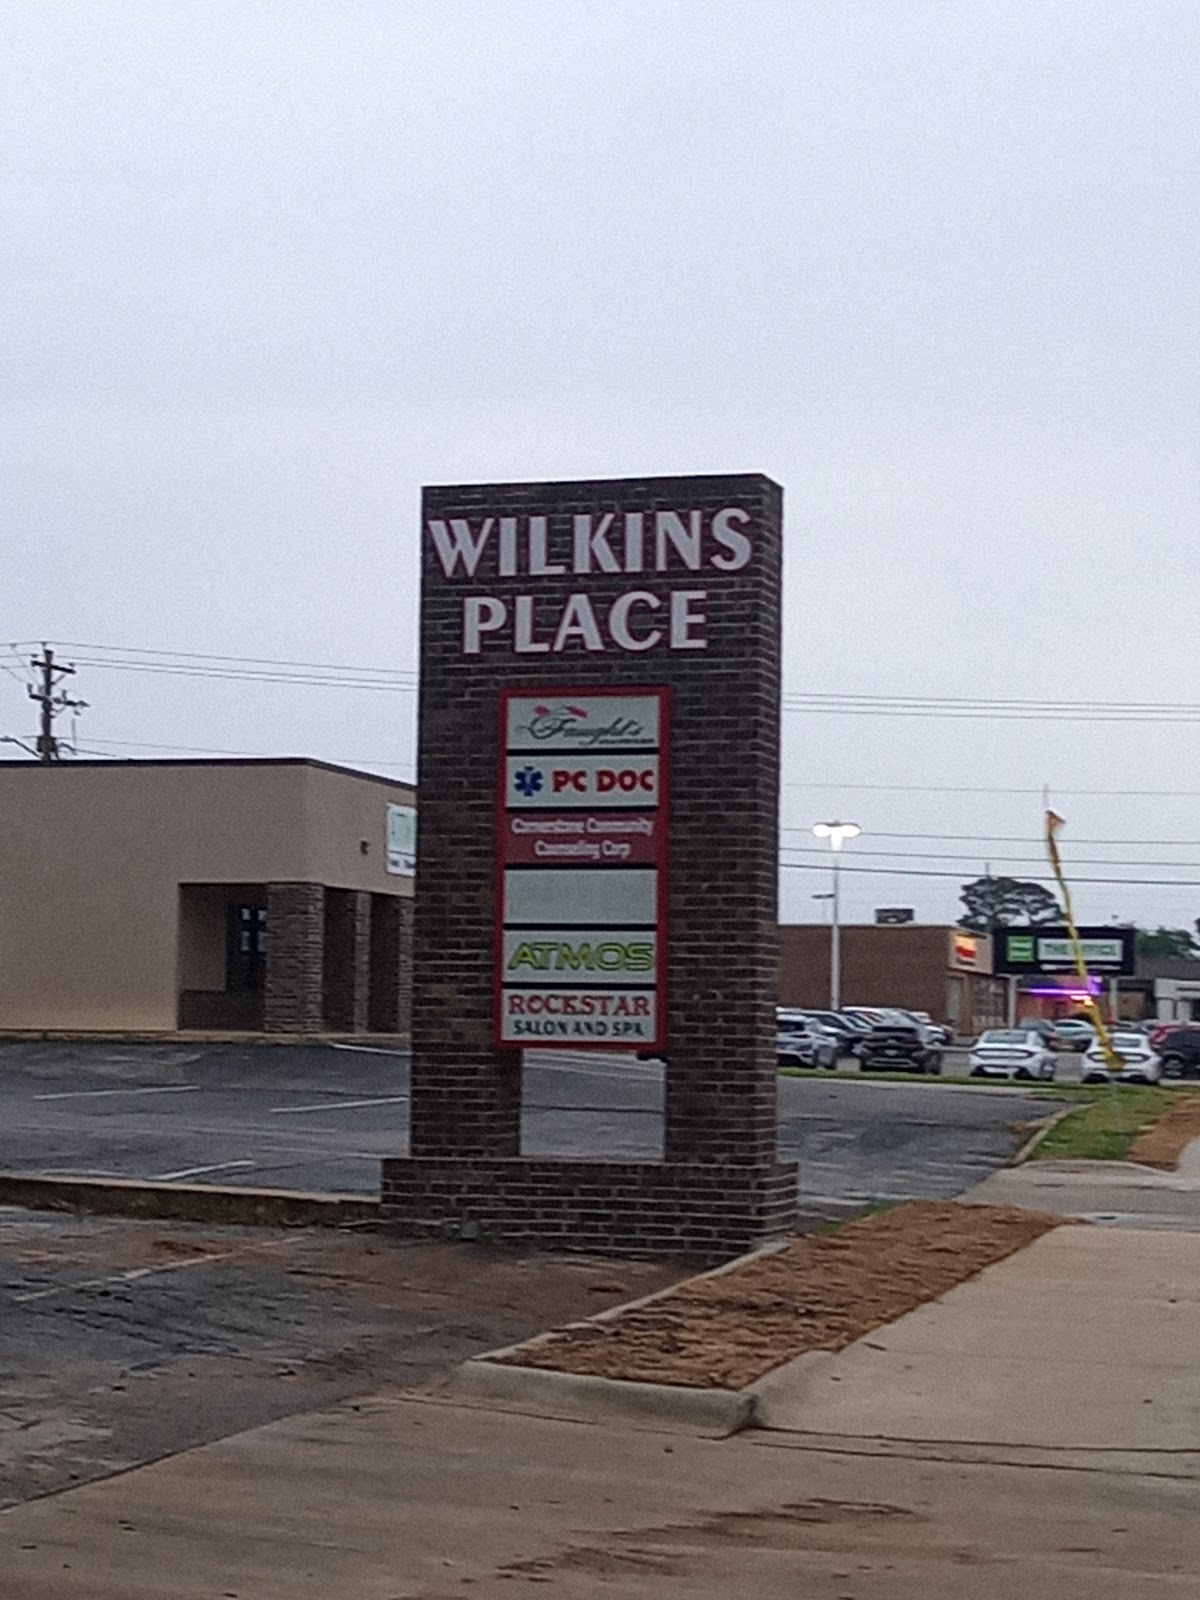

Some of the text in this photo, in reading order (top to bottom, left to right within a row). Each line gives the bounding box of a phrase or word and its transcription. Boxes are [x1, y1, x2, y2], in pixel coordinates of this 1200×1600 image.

[428, 508, 752, 578] WILKINS
[463, 590, 709, 654] PLACE
[552, 769, 655, 793] PC DOC
[507, 942, 655, 972] ATMOS
[508, 994, 651, 1016] ROCKSTAR
[513, 1019, 644, 1037] SALON AND SPA
